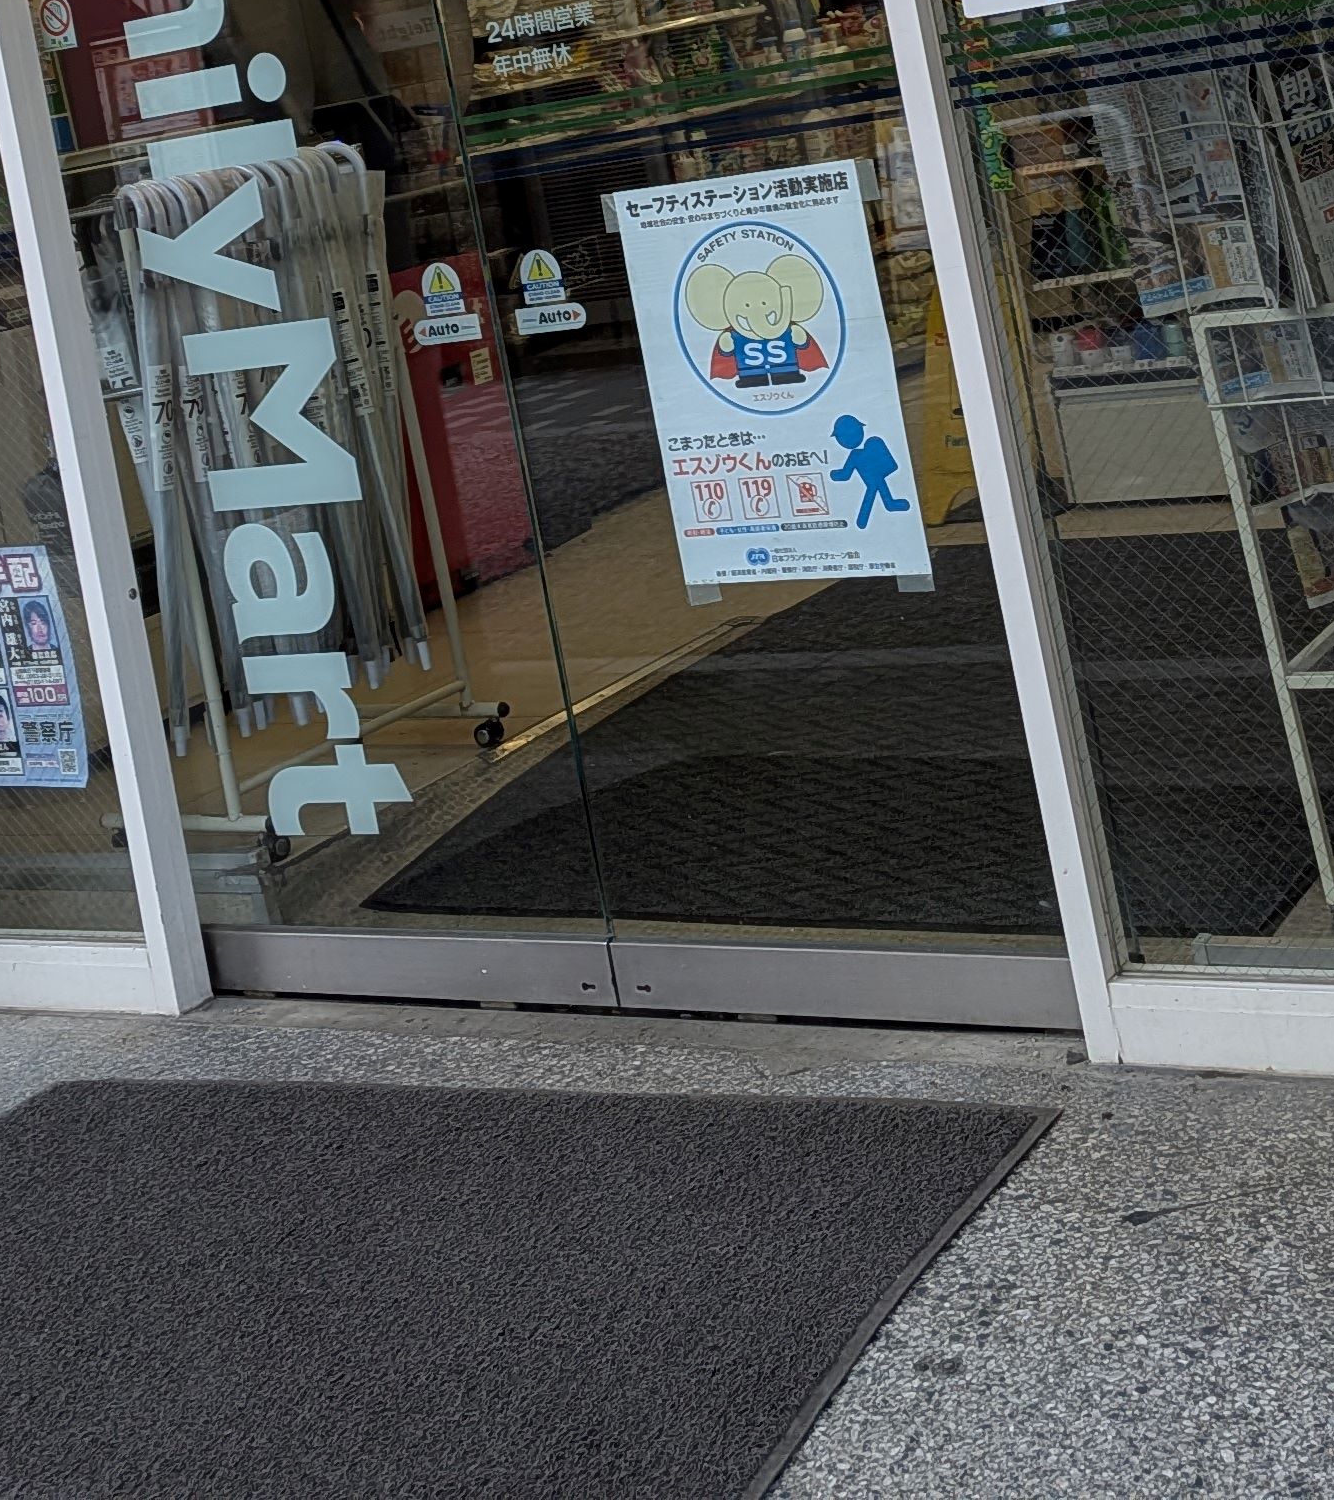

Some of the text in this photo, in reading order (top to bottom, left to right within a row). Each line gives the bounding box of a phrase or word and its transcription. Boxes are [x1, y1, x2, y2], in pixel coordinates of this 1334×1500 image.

[485, 1, 595, 45] 24時間営業
[492, 43, 573, 79] 年中無休
[625, 171, 849, 219] セーフティステーション活動実施店
[696, 228, 796, 264] SAFETY STATION
[526, 280, 561, 291] CAUTION
[427, 293, 461, 303] CAUTION
[539, 310, 572, 325] Auto
[428, 323, 460, 338] Auto
[744, 340, 788, 367] SS
[752, 390, 795, 403] エスゾウくん
[667, 430, 767, 452] こまったときは…
[694, 481, 726, 502] 110
[742, 478, 773, 499] 119
[771, 551, 861, 564] 日本フランチャイズチェーン協会
[20, 719, 77, 746] 警察庁
